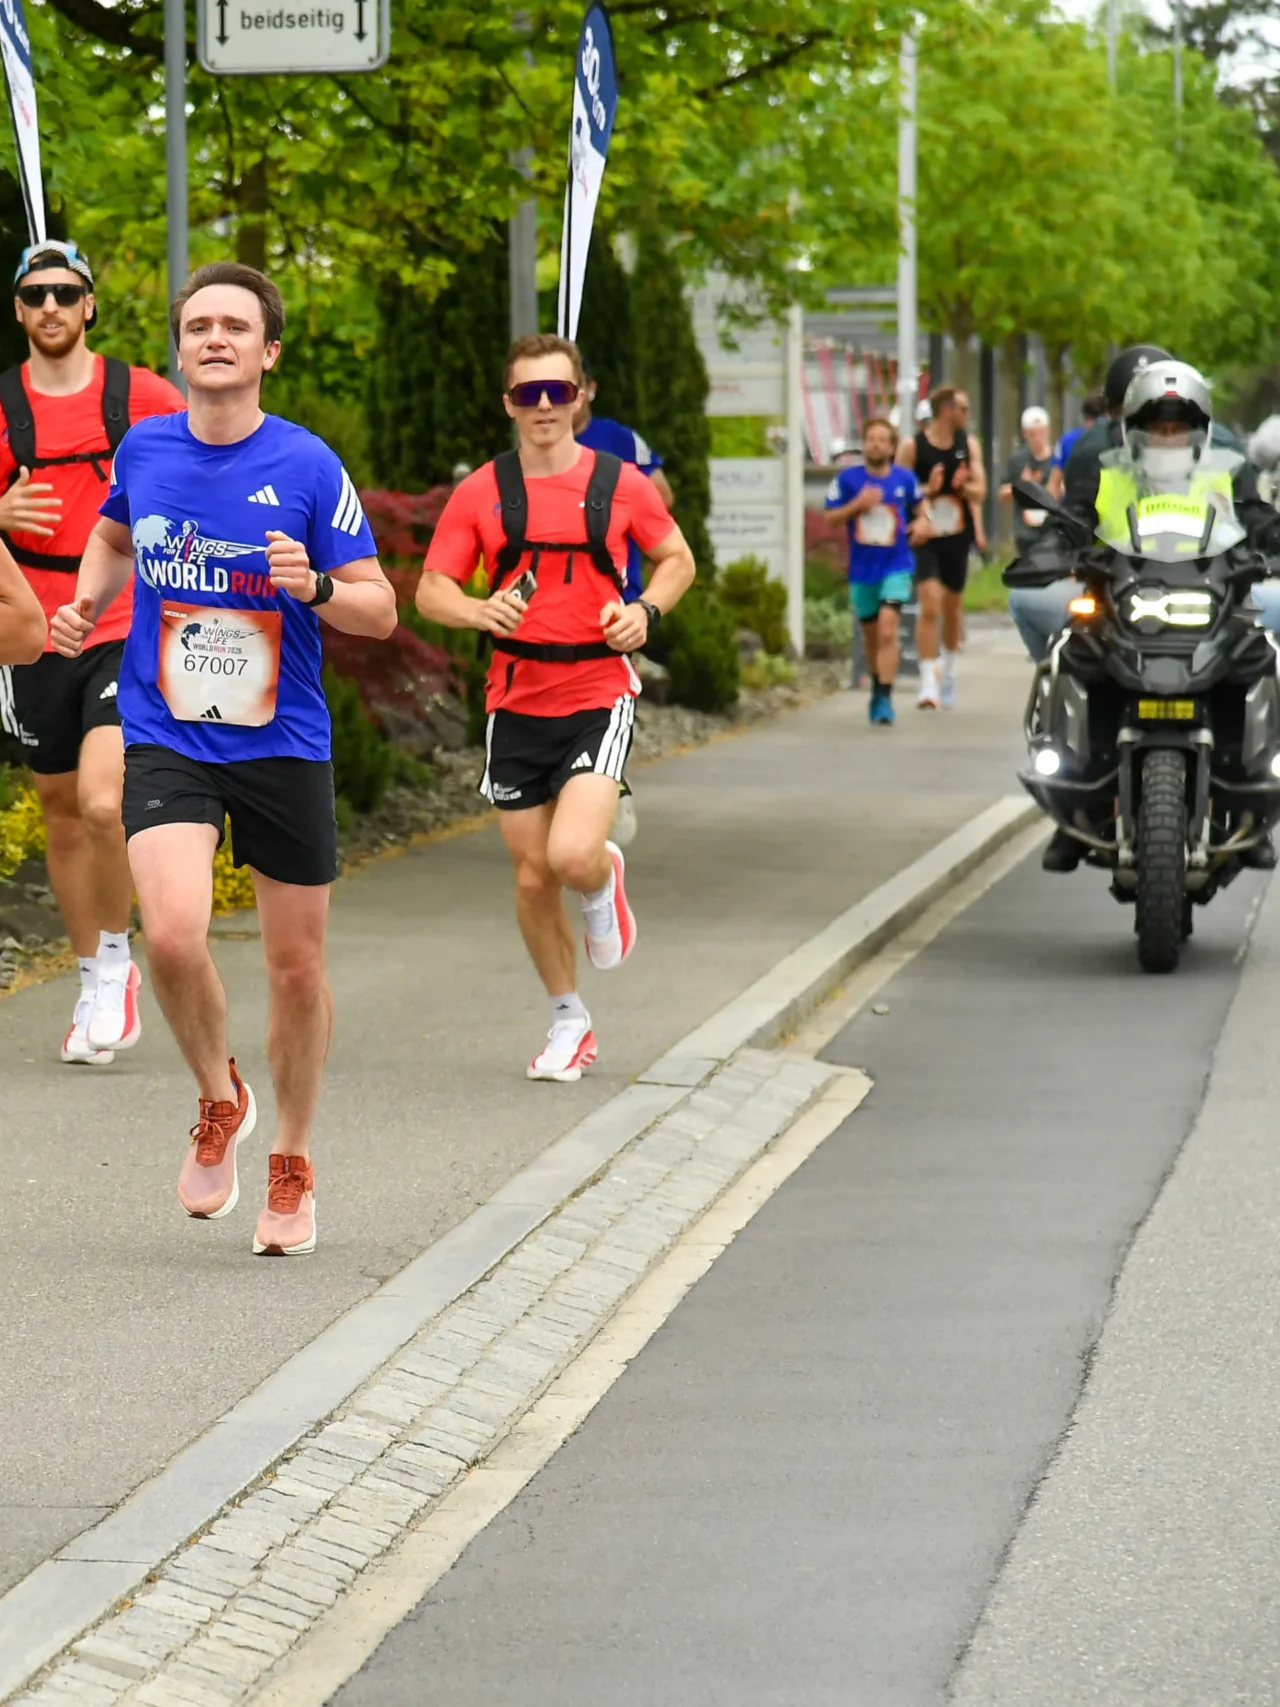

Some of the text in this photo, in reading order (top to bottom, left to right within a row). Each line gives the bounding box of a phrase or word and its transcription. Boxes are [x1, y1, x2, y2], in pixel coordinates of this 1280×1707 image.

[240, 9, 344, 34] beidseitig
[167, 533, 227, 556] WINGS
[174, 548, 208, 566] LIFE
[147, 558, 228, 593] WORLD
[204, 626, 241, 639] WINGS
[193, 643, 242, 655] WORLD RUN 2026
[184, 654, 248, 676] 67007
